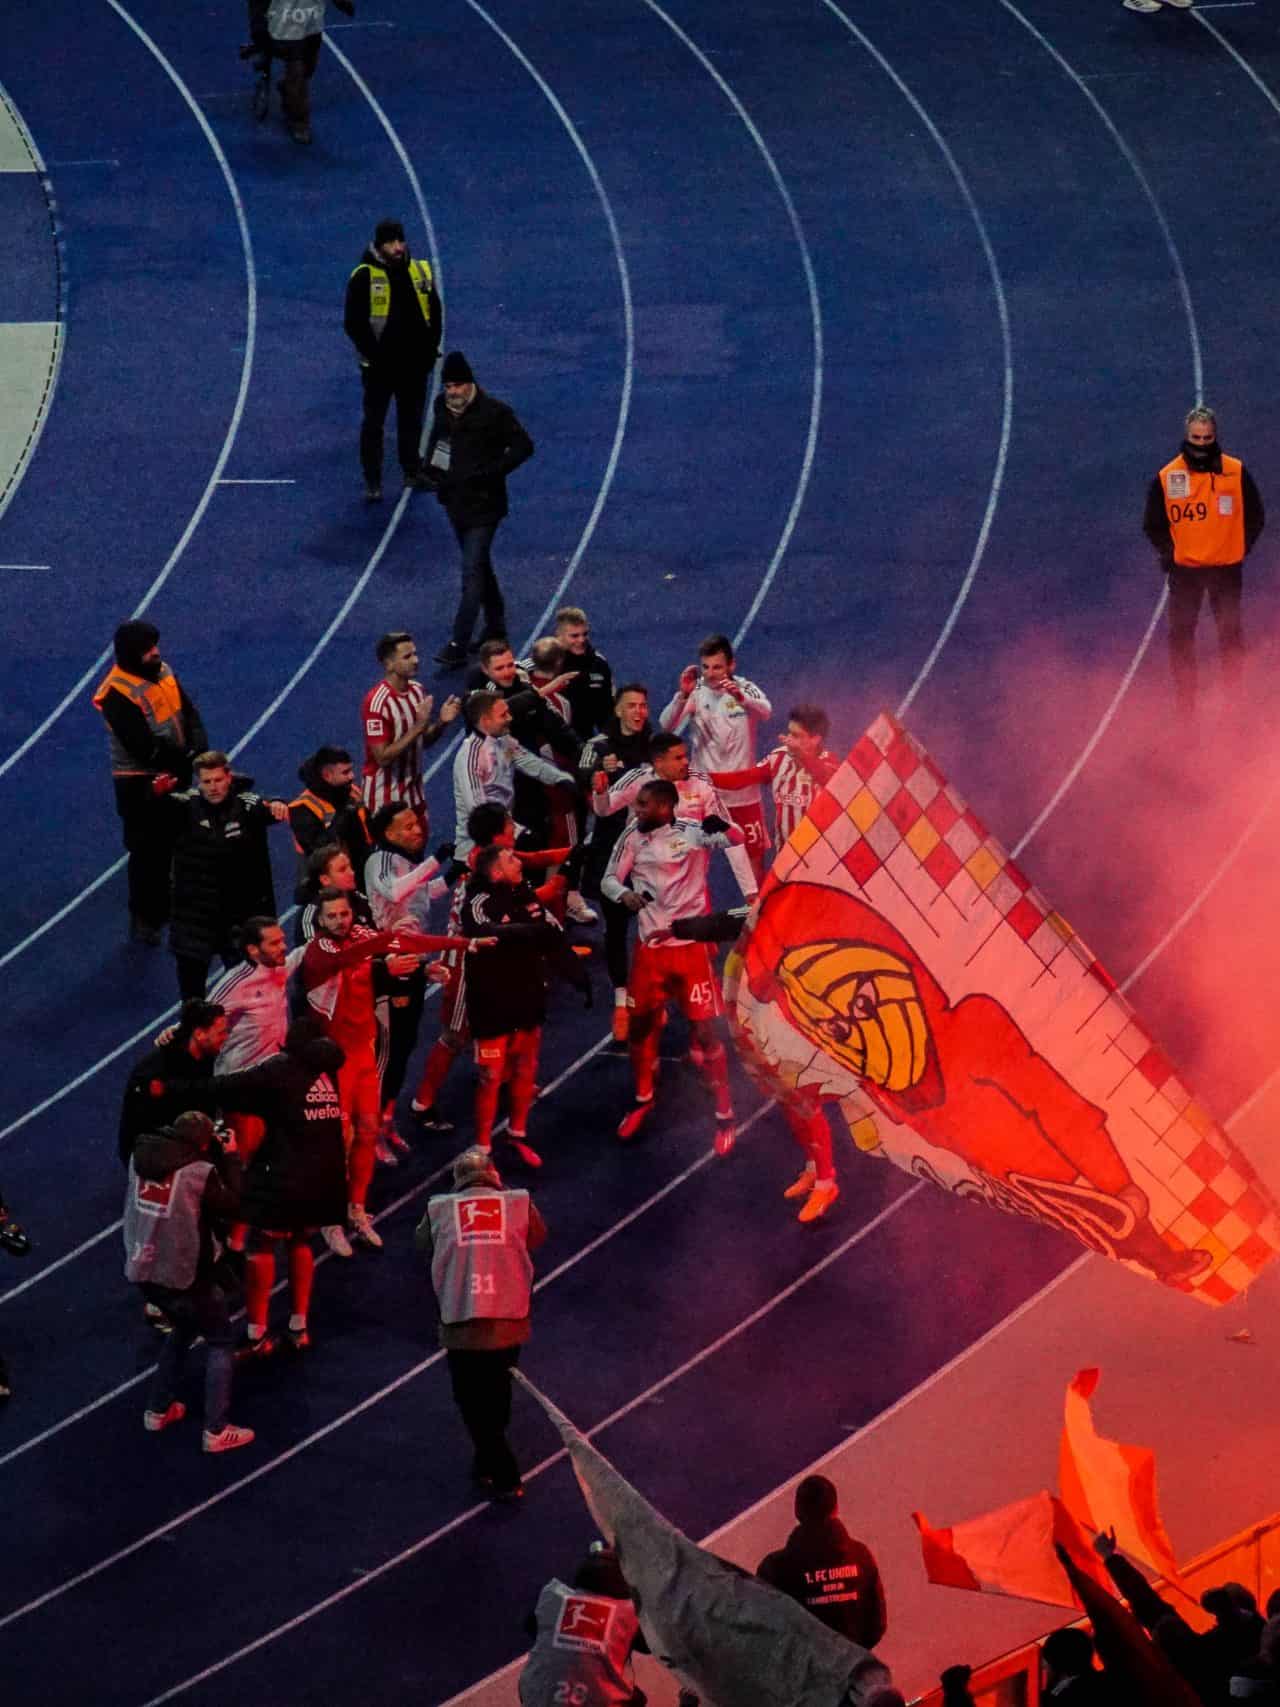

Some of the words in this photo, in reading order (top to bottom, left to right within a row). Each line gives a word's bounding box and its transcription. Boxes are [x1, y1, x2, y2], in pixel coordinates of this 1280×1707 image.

[1170, 502, 1208, 523] 049
[689, 980, 712, 1005] 45
[470, 1272, 497, 1295] 31
[815, 1568, 828, 1582] FC
